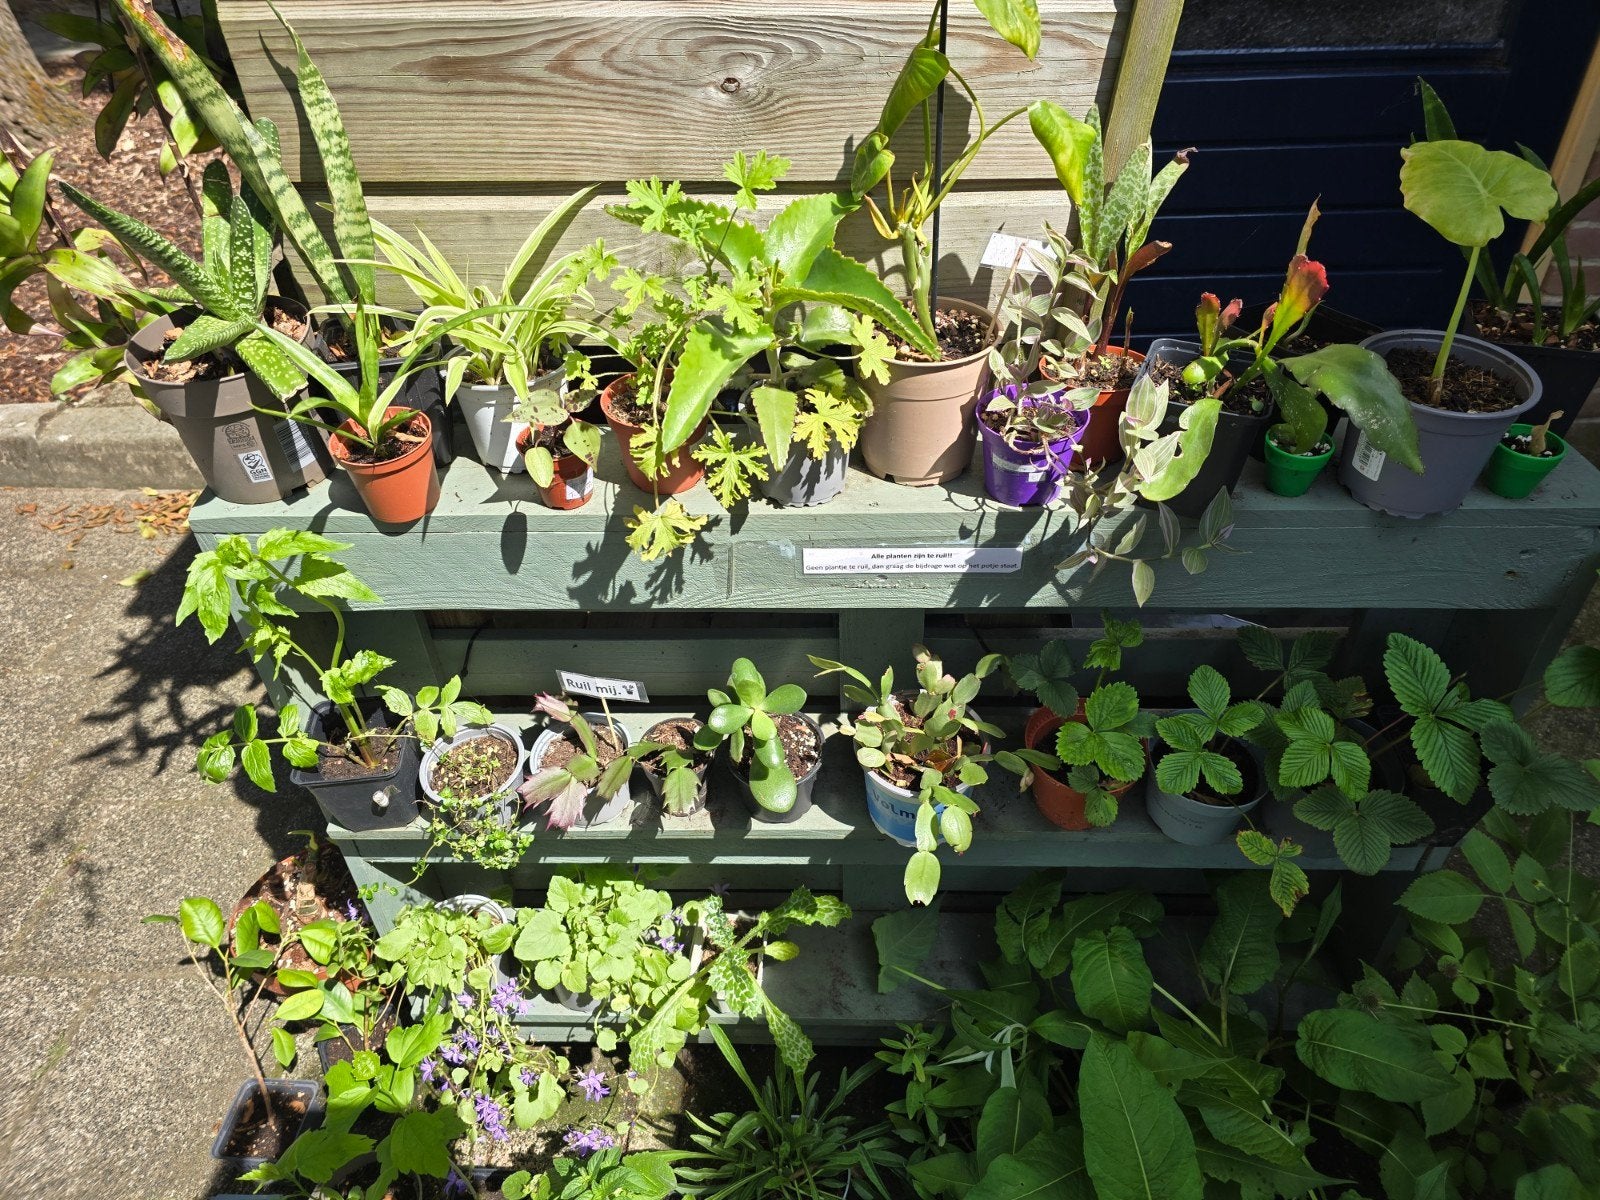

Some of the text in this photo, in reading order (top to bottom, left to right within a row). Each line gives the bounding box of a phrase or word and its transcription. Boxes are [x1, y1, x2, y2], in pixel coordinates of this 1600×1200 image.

[566, 678, 622, 696] Ruil mij.
[873, 788, 916, 820] Volm
